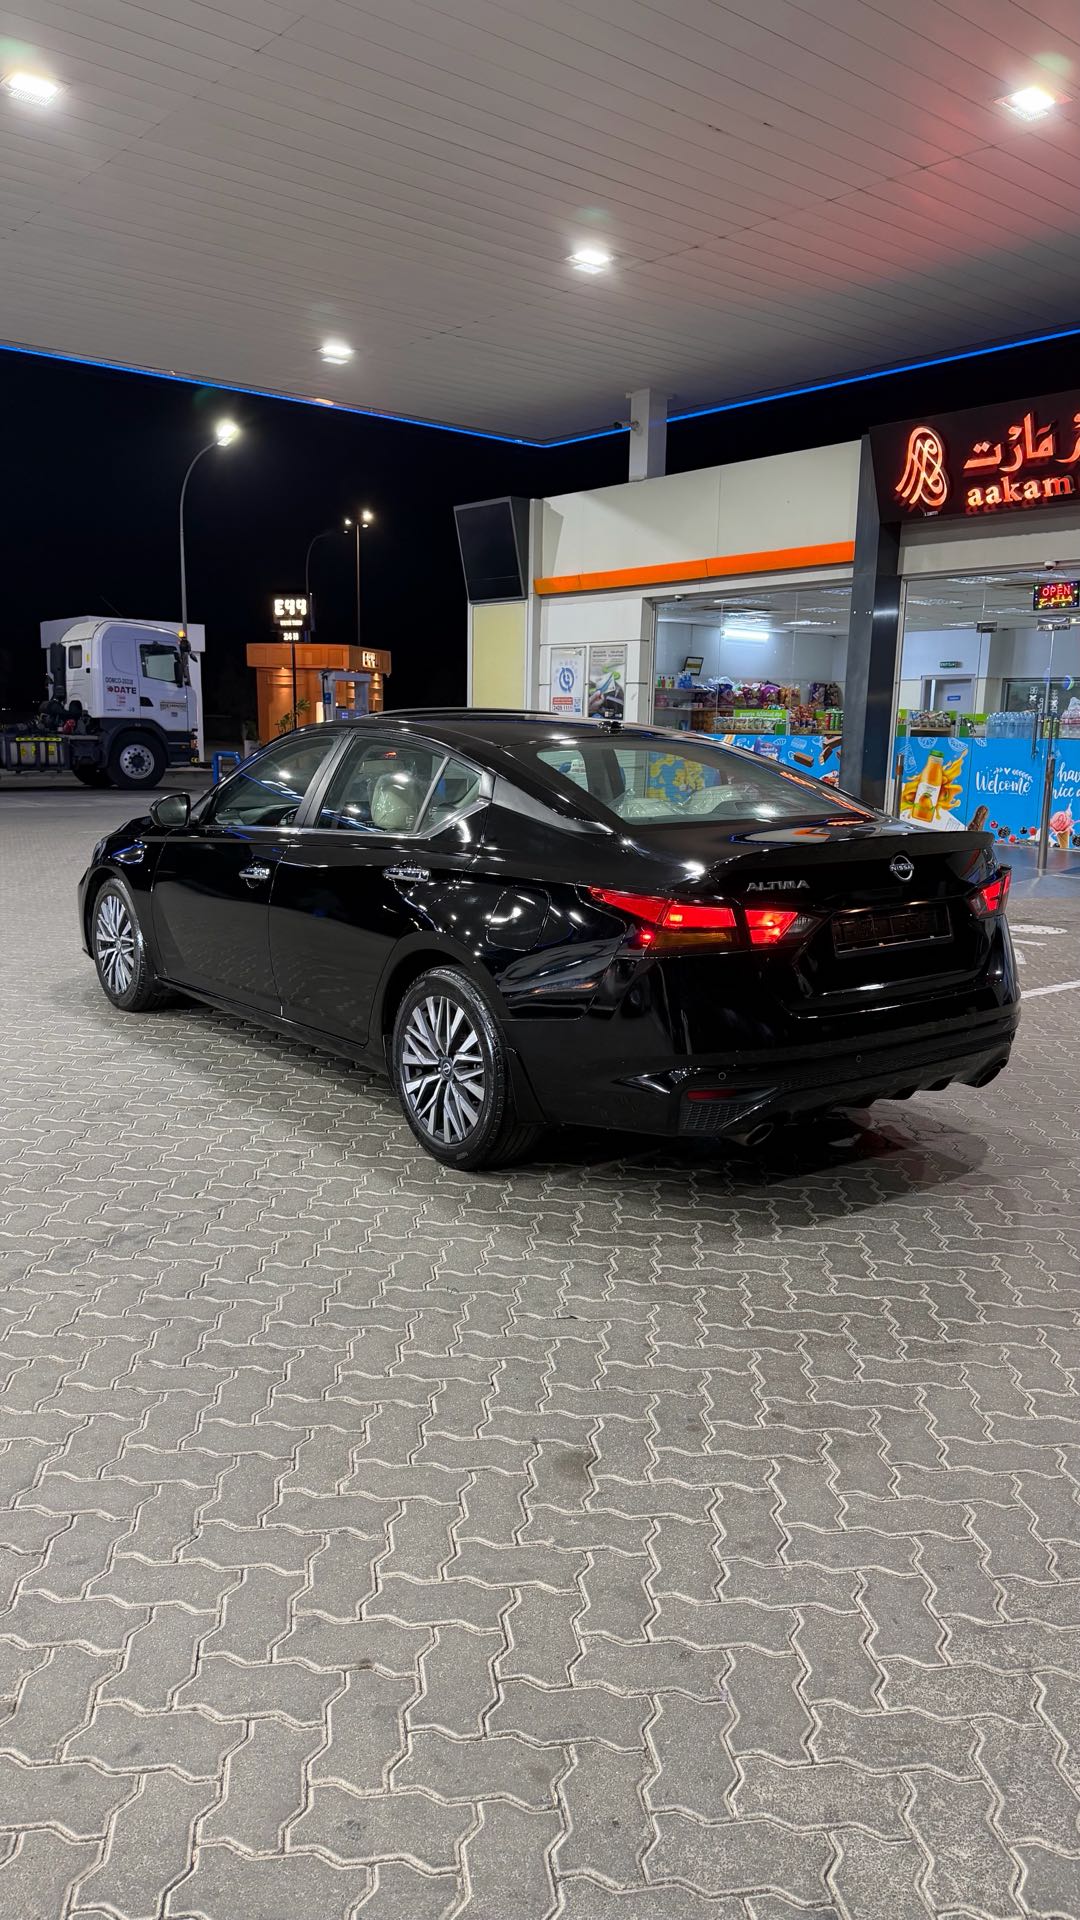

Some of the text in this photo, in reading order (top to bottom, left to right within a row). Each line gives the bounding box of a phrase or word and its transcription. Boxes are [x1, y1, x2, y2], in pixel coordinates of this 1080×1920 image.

[967, 475, 1073, 507] aakam
[1042, 585, 1071, 597] OPEN
[1039, 595, 1073, 606] مفتوح
[114, 685, 137, 695] DATE
[976, 771, 1031, 796] Welcome
[746, 879, 811, 892] ALTIMA
